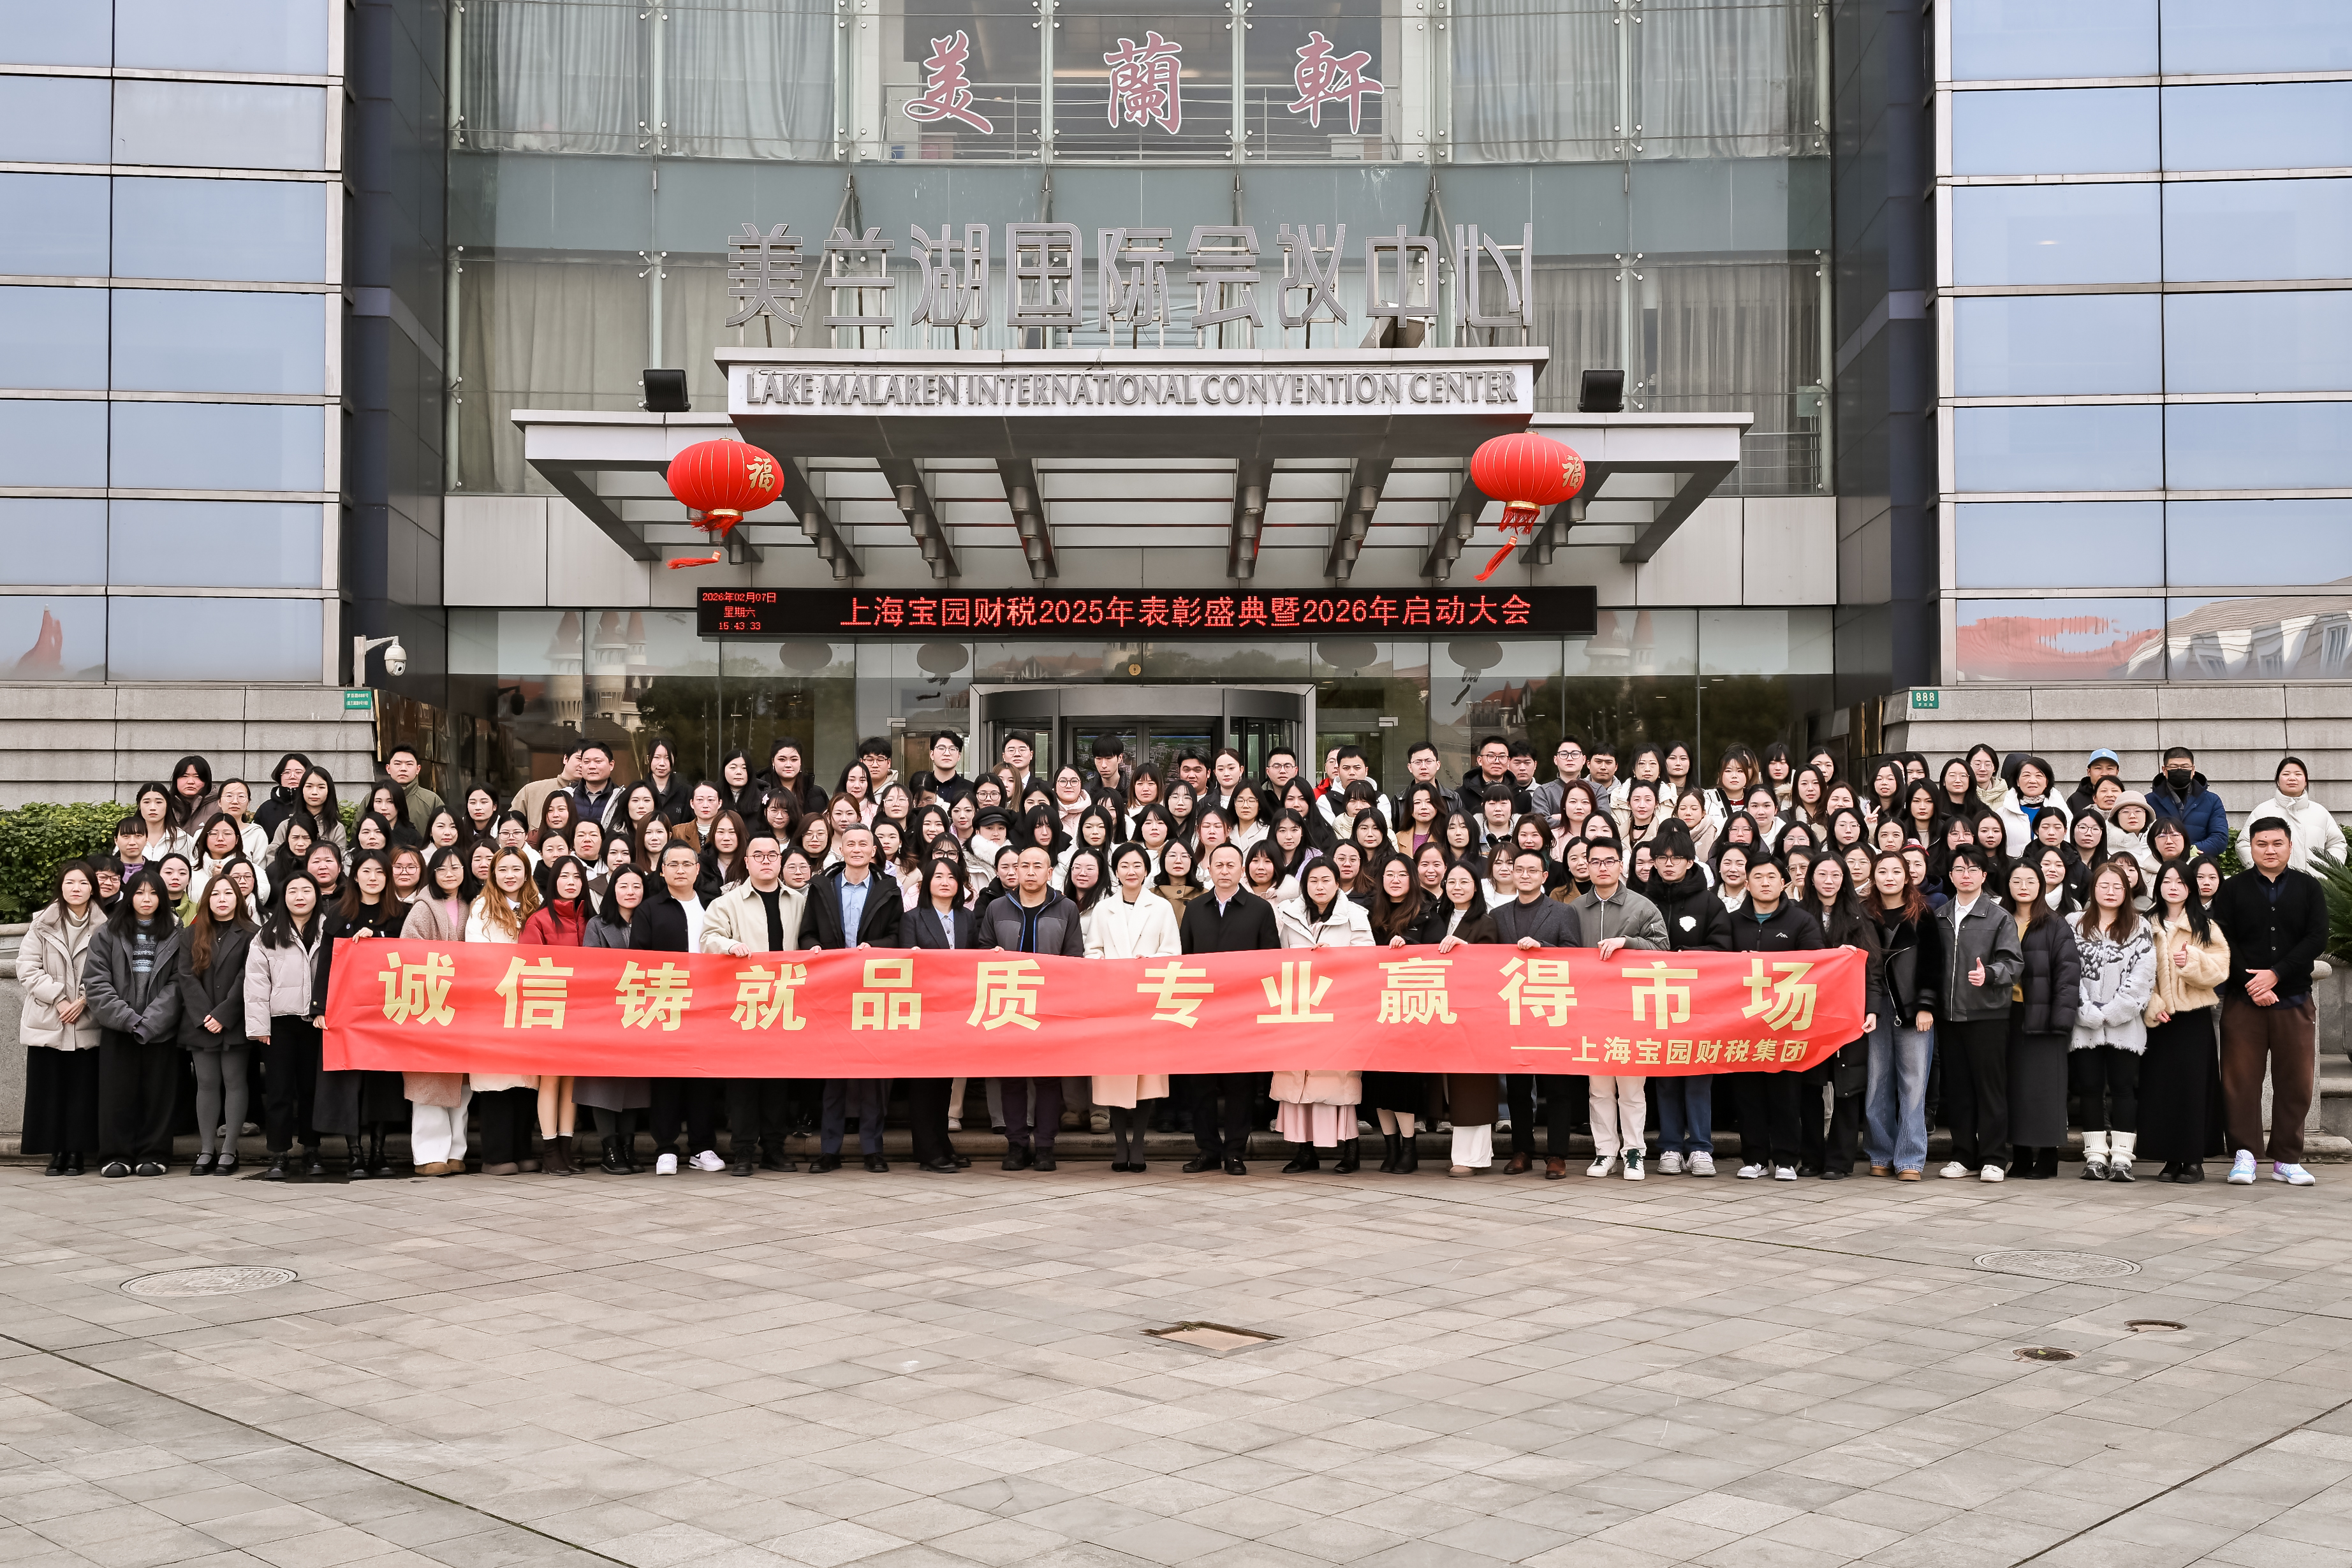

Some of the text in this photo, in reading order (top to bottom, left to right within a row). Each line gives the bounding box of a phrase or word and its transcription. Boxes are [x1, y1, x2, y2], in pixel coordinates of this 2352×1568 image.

[902, 29, 1384, 135] 美蘭軒
[725, 223, 1532, 332] 美兰湖国际会议中心
[746, 372, 1518, 405] LAKE MALAREN INTERNATIONAL CONVENTION CENTER
[746, 455, 775, 492] 福
[1562, 454, 1583, 490] 福
[702, 591, 776, 603] 2026年02月07日
[724, 606, 756, 617] 星期六
[840, 594, 1532, 628] 上海宝园财税2025年表彰盛典暨2026年启动大会
[719, 622, 761, 630] 15:43:33
[1916, 692, 1934, 701] 888
[378, 951, 1819, 1032] 诚信铸就品质 专业赢得市场
